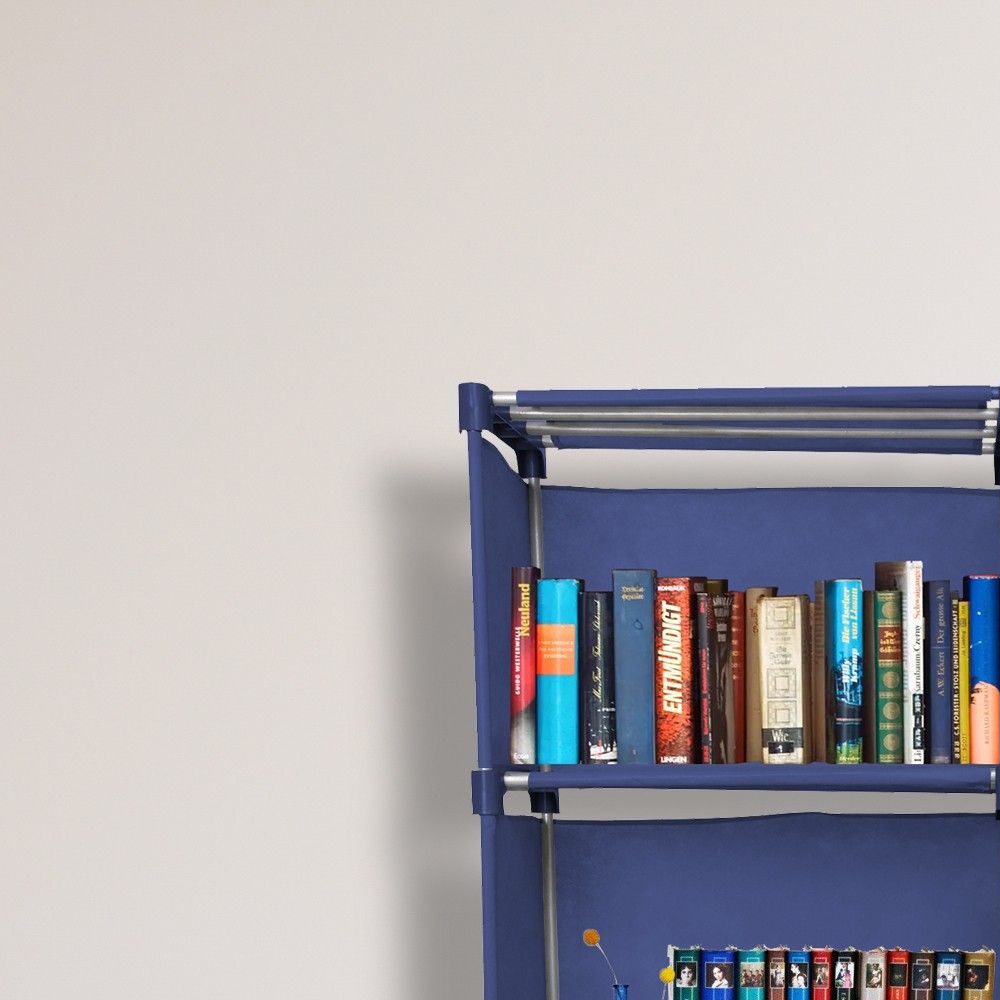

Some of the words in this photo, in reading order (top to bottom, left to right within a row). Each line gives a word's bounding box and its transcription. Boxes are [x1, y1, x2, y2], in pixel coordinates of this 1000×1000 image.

[518, 583, 530, 637] Neuland
[657, 600, 683, 715] ENTMÜNDIGT
[914, 625, 922, 652] Czerny
[660, 756, 688, 764] LINGEN
